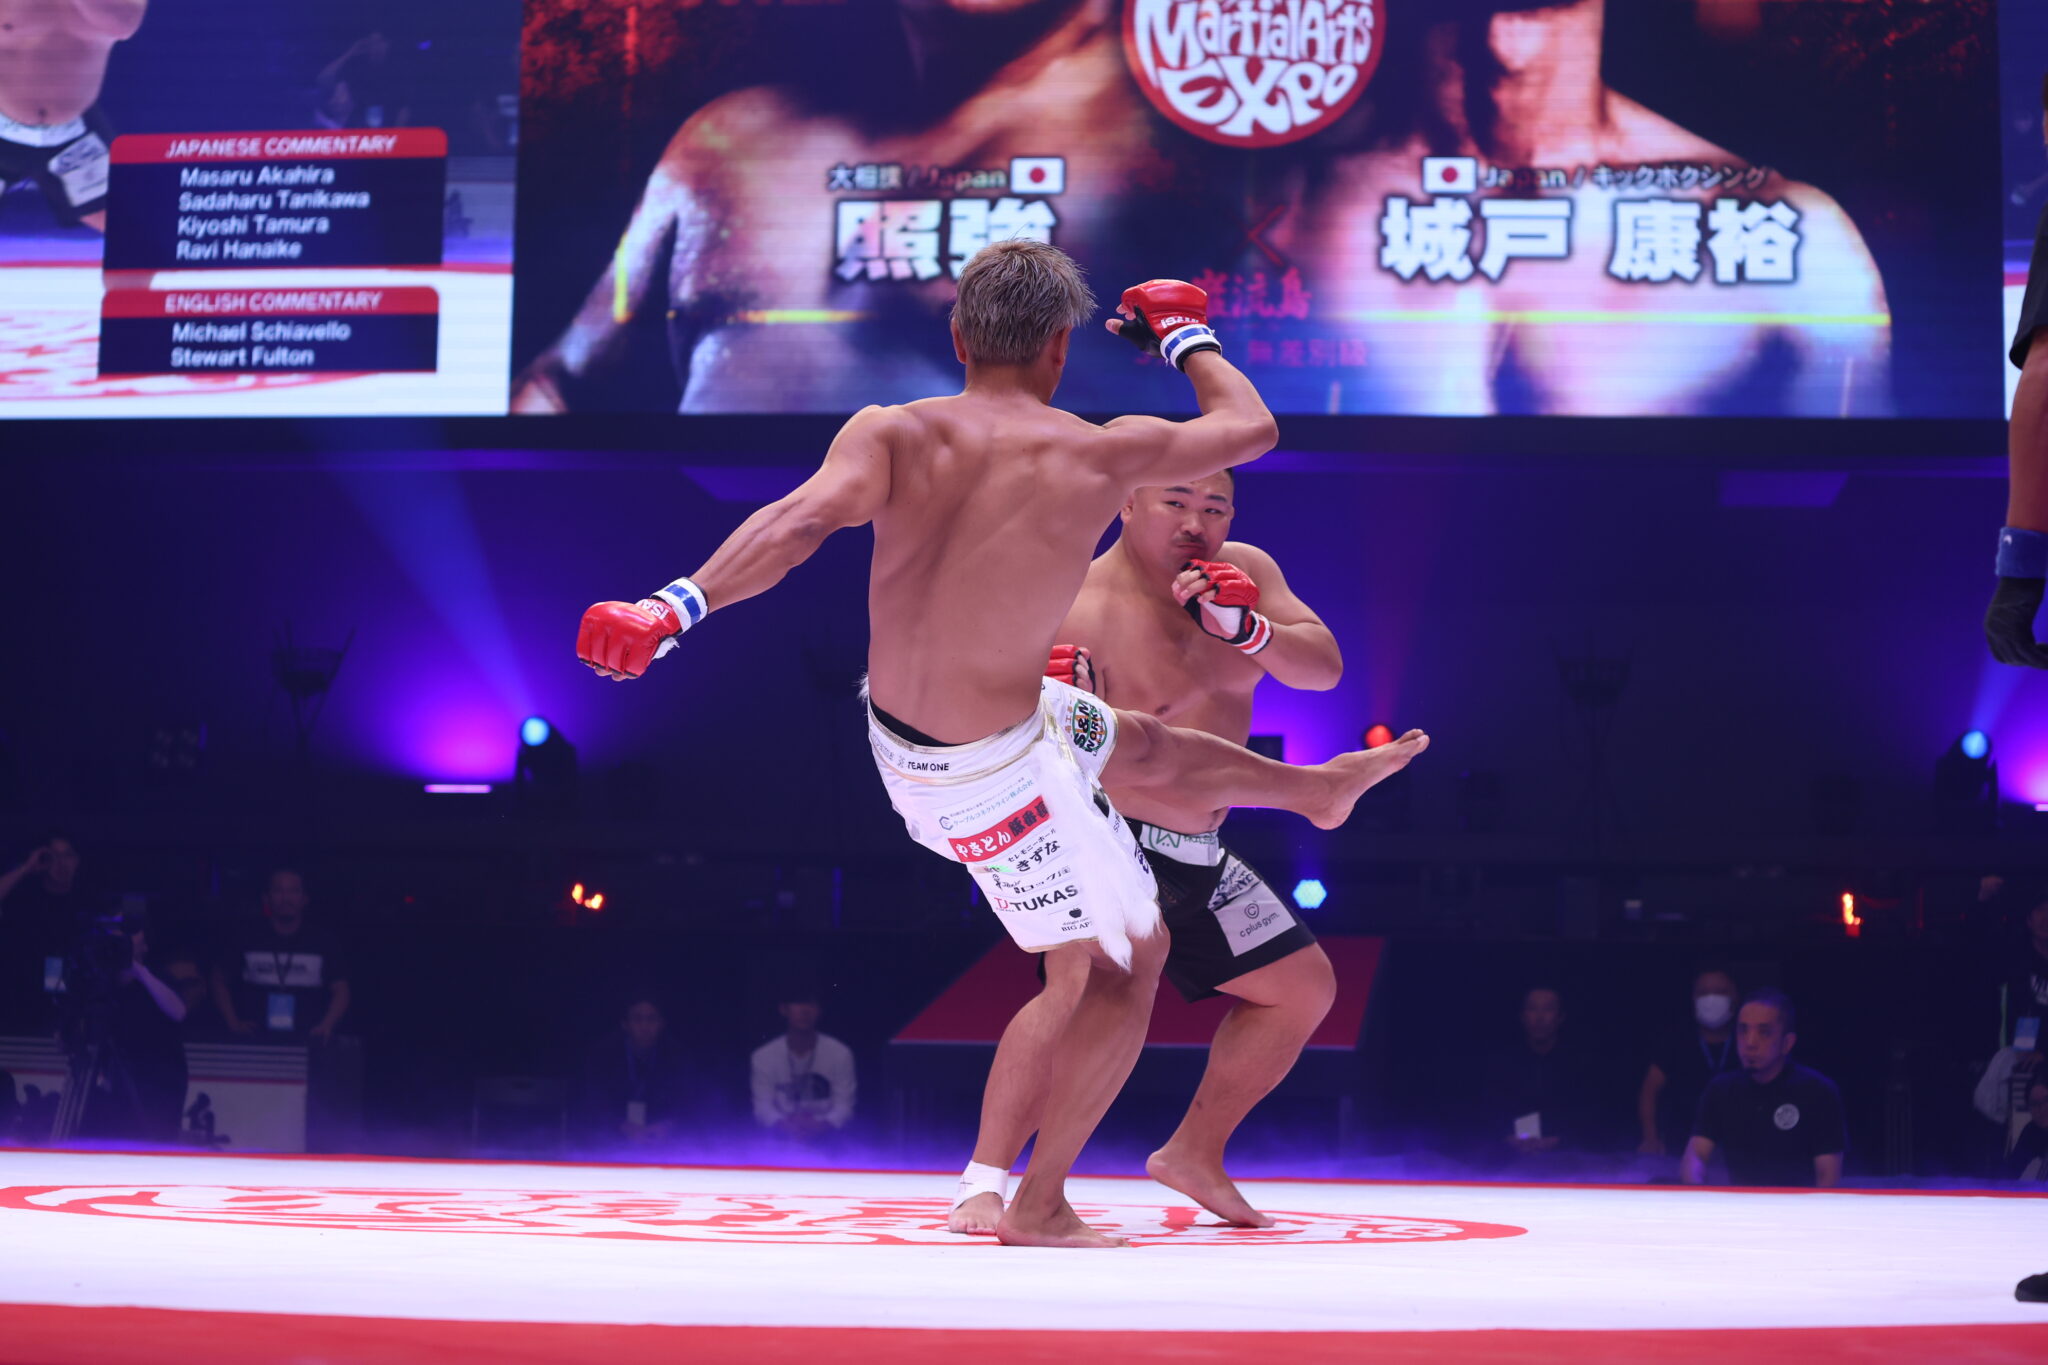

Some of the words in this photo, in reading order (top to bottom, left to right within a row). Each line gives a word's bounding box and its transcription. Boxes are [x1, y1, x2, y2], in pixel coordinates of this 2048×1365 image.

[165, 137, 262, 158] JAPANESE
[264, 134, 397, 156] COMMENTARY
[180, 167, 253, 188] Masaru
[256, 164, 336, 186] Akahira
[178, 191, 273, 212] Sadaharu
[276, 188, 371, 210] Tanikawa
[177, 214, 249, 240] Kiyoshi
[252, 213, 330, 235] Tamura
[176, 239, 219, 261] Ravi
[222, 238, 303, 260] Hanaike
[1380, 196, 1573, 282] 城戸
[1606, 196, 1800, 284] 康裕
[164, 292, 247, 314] ENGLISH
[249, 291, 384, 312] COMMENTARY
[171, 321, 248, 343] Michael
[250, 320, 352, 342] Schiavello
[170, 346, 248, 368] Stewart
[251, 345, 315, 367] Fulton
[907, 761, 929, 771] TEAM
[929, 762, 950, 771] ONE
[1016, 840, 1061, 872] きずな
[1009, 885, 1079, 911] TUKAS
[1246, 920, 1263, 936] plus
